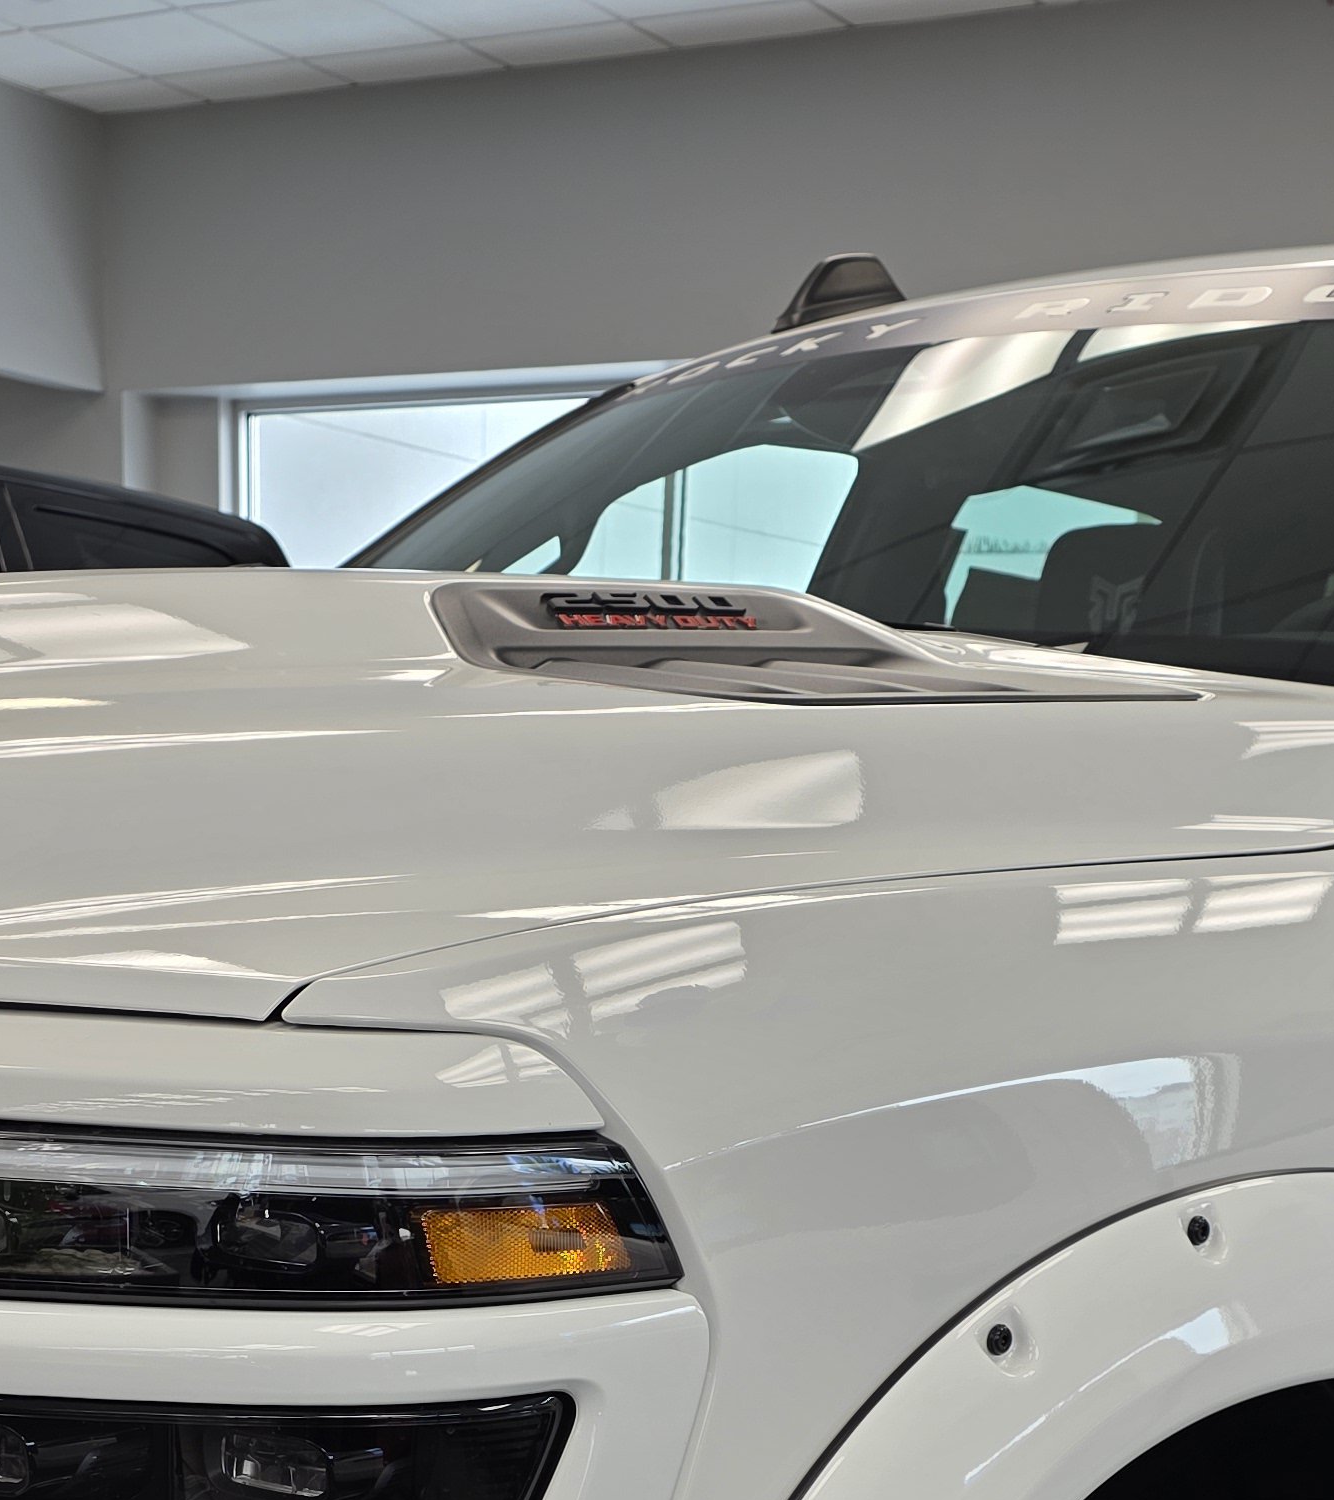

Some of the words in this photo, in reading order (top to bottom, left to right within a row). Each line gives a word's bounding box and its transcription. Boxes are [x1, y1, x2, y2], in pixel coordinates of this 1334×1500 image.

[540, 592, 747, 616] 2500
[555, 613, 668, 630] HEAVY
[671, 614, 758, 630] DUTY
